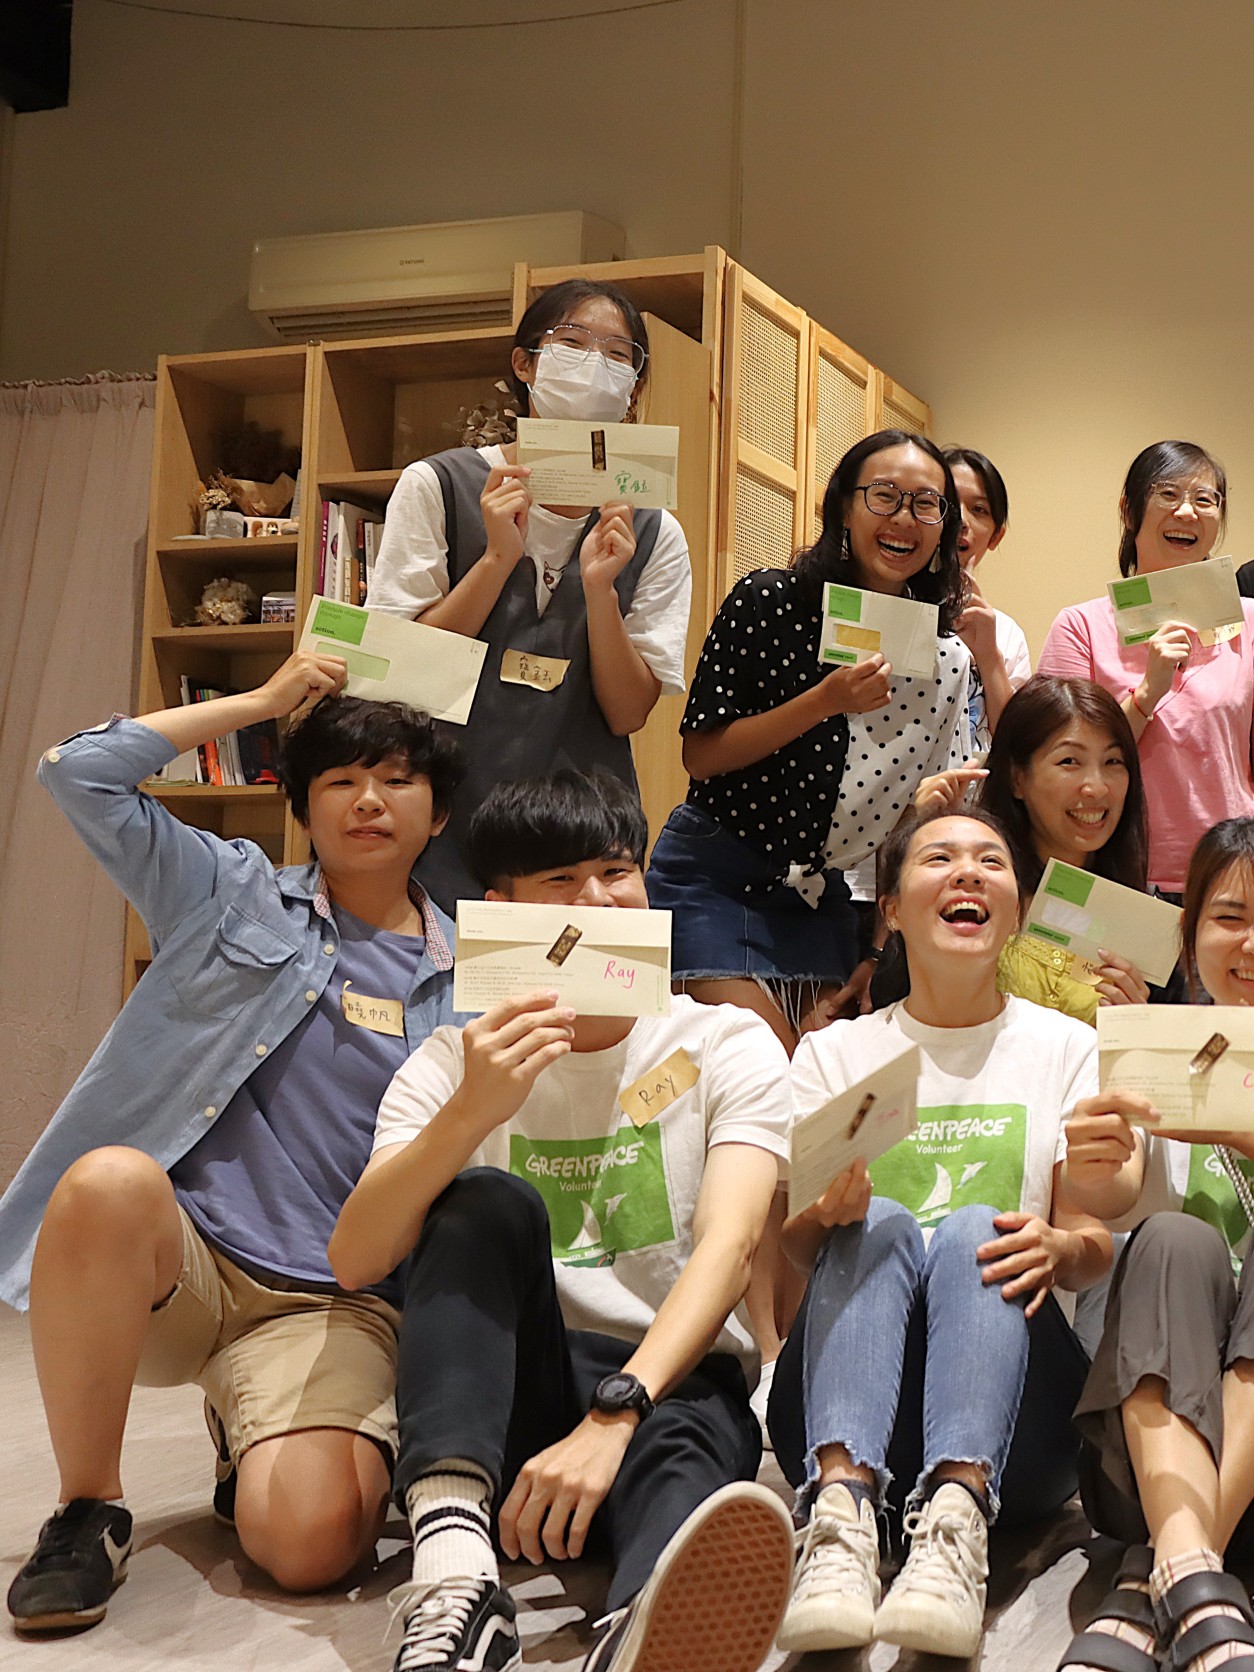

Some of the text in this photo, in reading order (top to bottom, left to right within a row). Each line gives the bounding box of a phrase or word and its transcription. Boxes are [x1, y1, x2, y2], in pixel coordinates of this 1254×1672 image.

[604, 959, 635, 989] Ray
[638, 1074, 676, 1107] Ray
[916, 1143, 963, 1154] Volunteer
